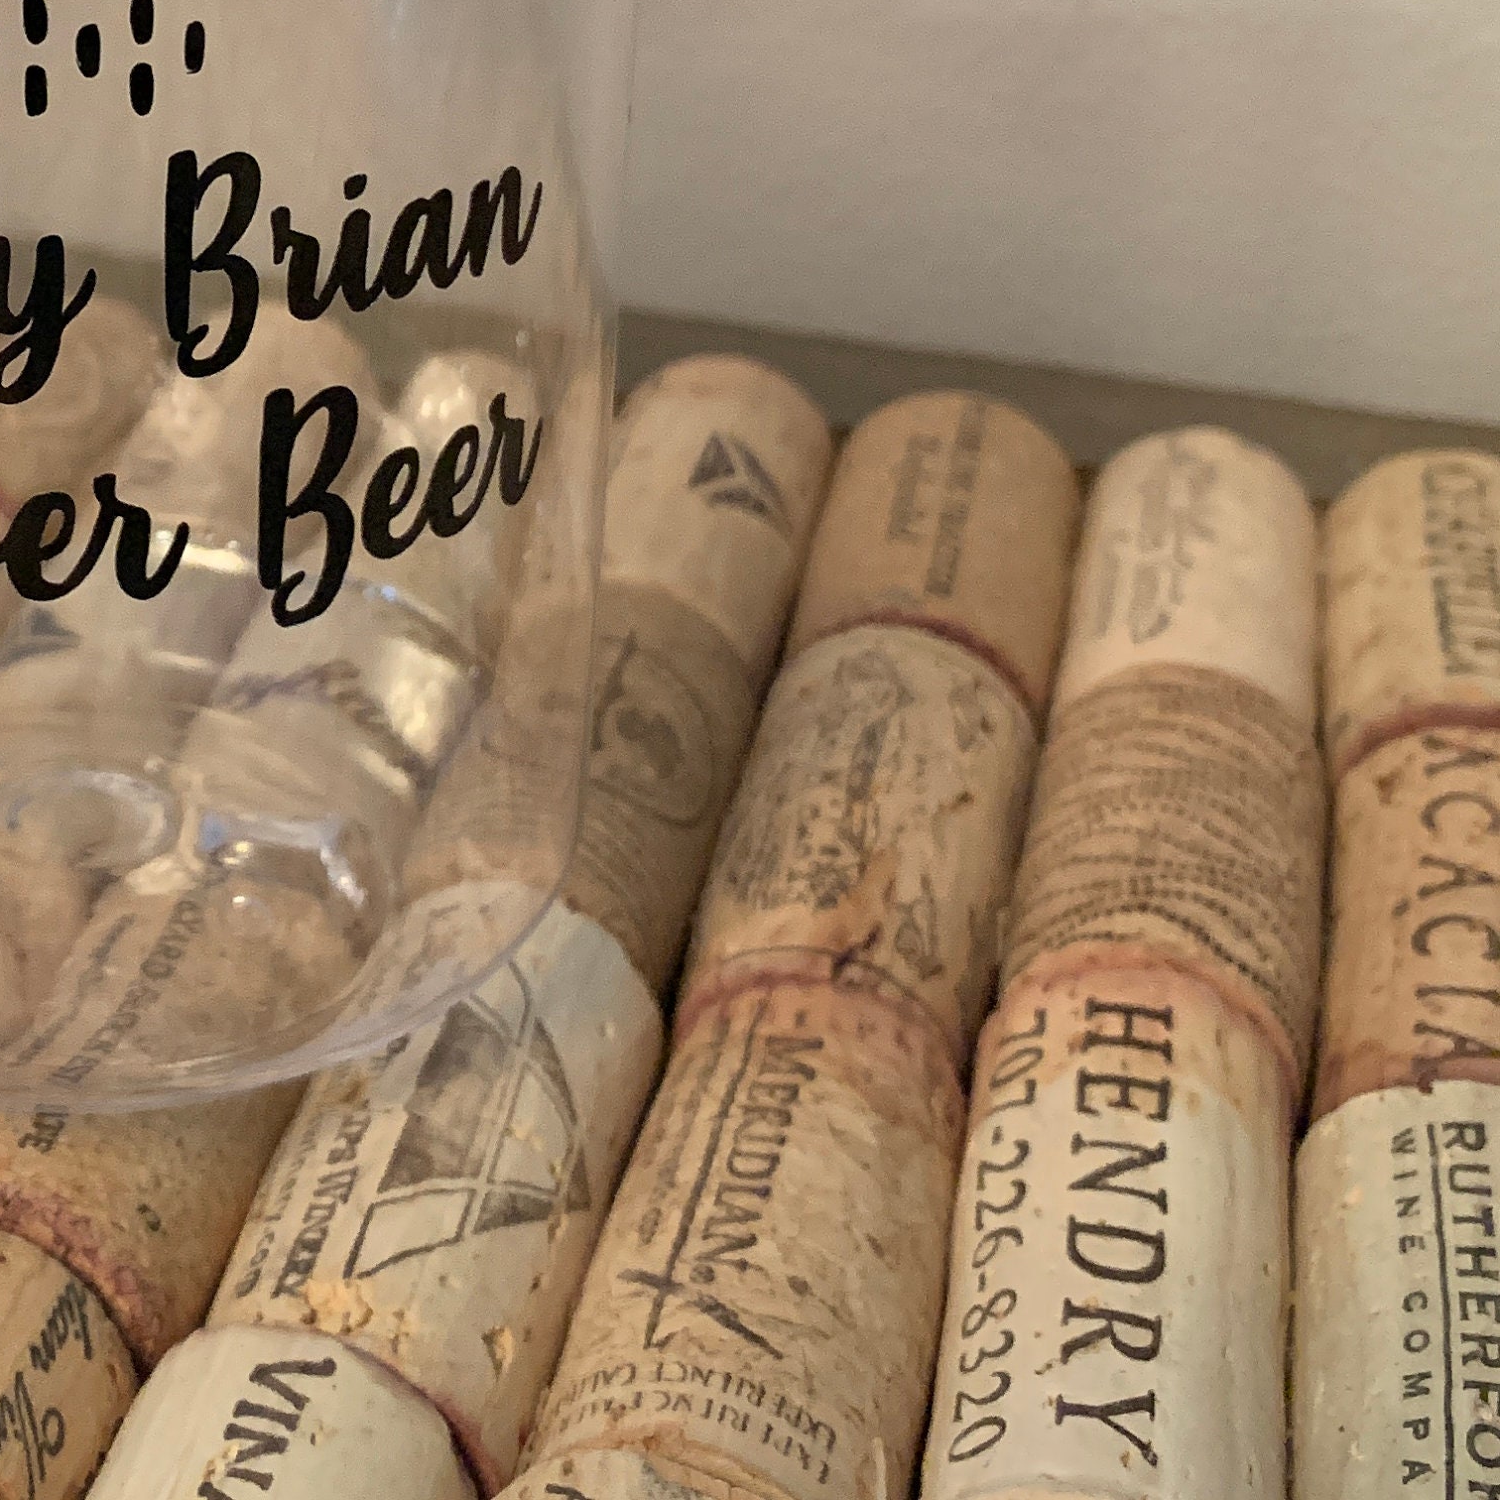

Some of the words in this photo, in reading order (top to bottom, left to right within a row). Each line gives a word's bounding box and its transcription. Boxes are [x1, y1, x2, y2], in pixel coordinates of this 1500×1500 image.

[164, 149, 543, 378] Brian
[258, 384, 543, 627] Beer
[947, 1007, 1047, 1465] 707-226-8320
[1054, 997, 1174, 1467] HENDRY
[1390, 1126, 1427, 1255] WINE
[197, 1356, 338, 1500] VIN
